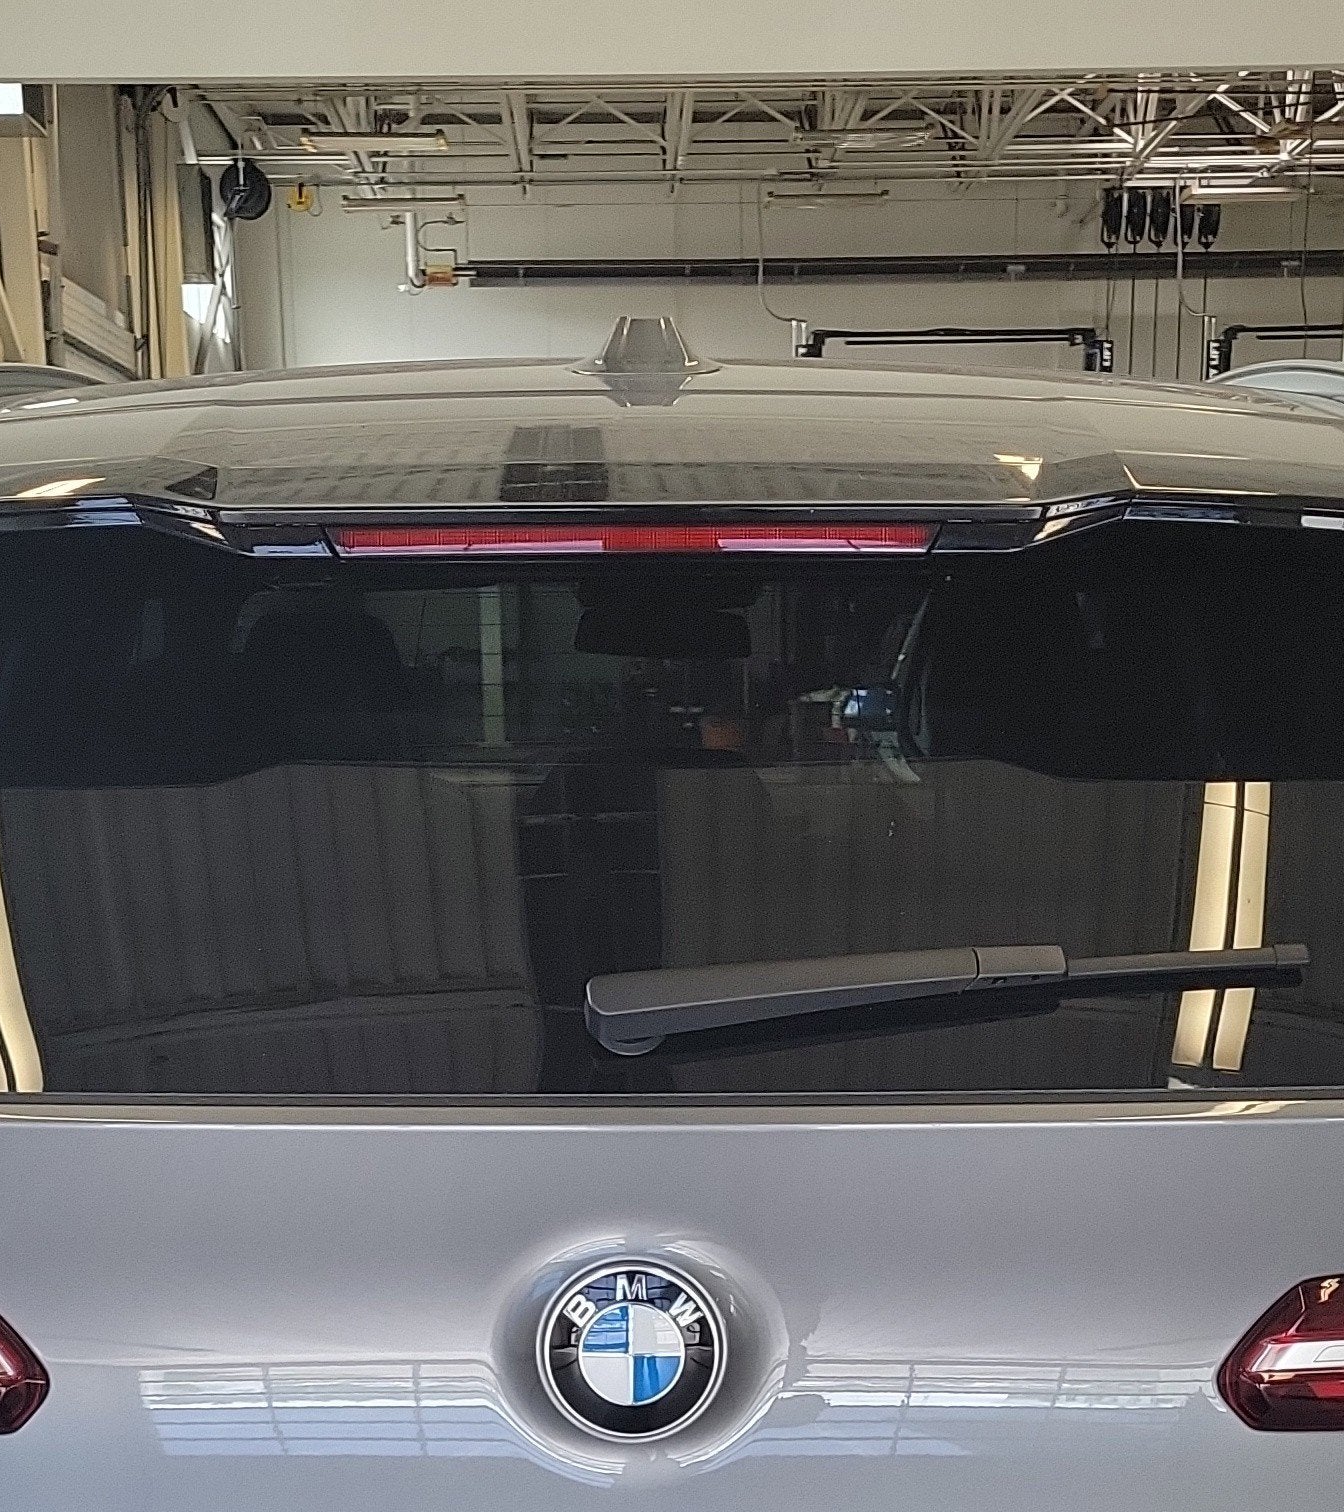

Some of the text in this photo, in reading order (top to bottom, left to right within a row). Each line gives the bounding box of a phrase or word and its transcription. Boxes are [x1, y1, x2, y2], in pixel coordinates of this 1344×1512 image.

[1102, 342, 1112, 366] LIFT
[1209, 342, 1220, 366] LIFT
[562, 1273, 704, 1330] BMW
